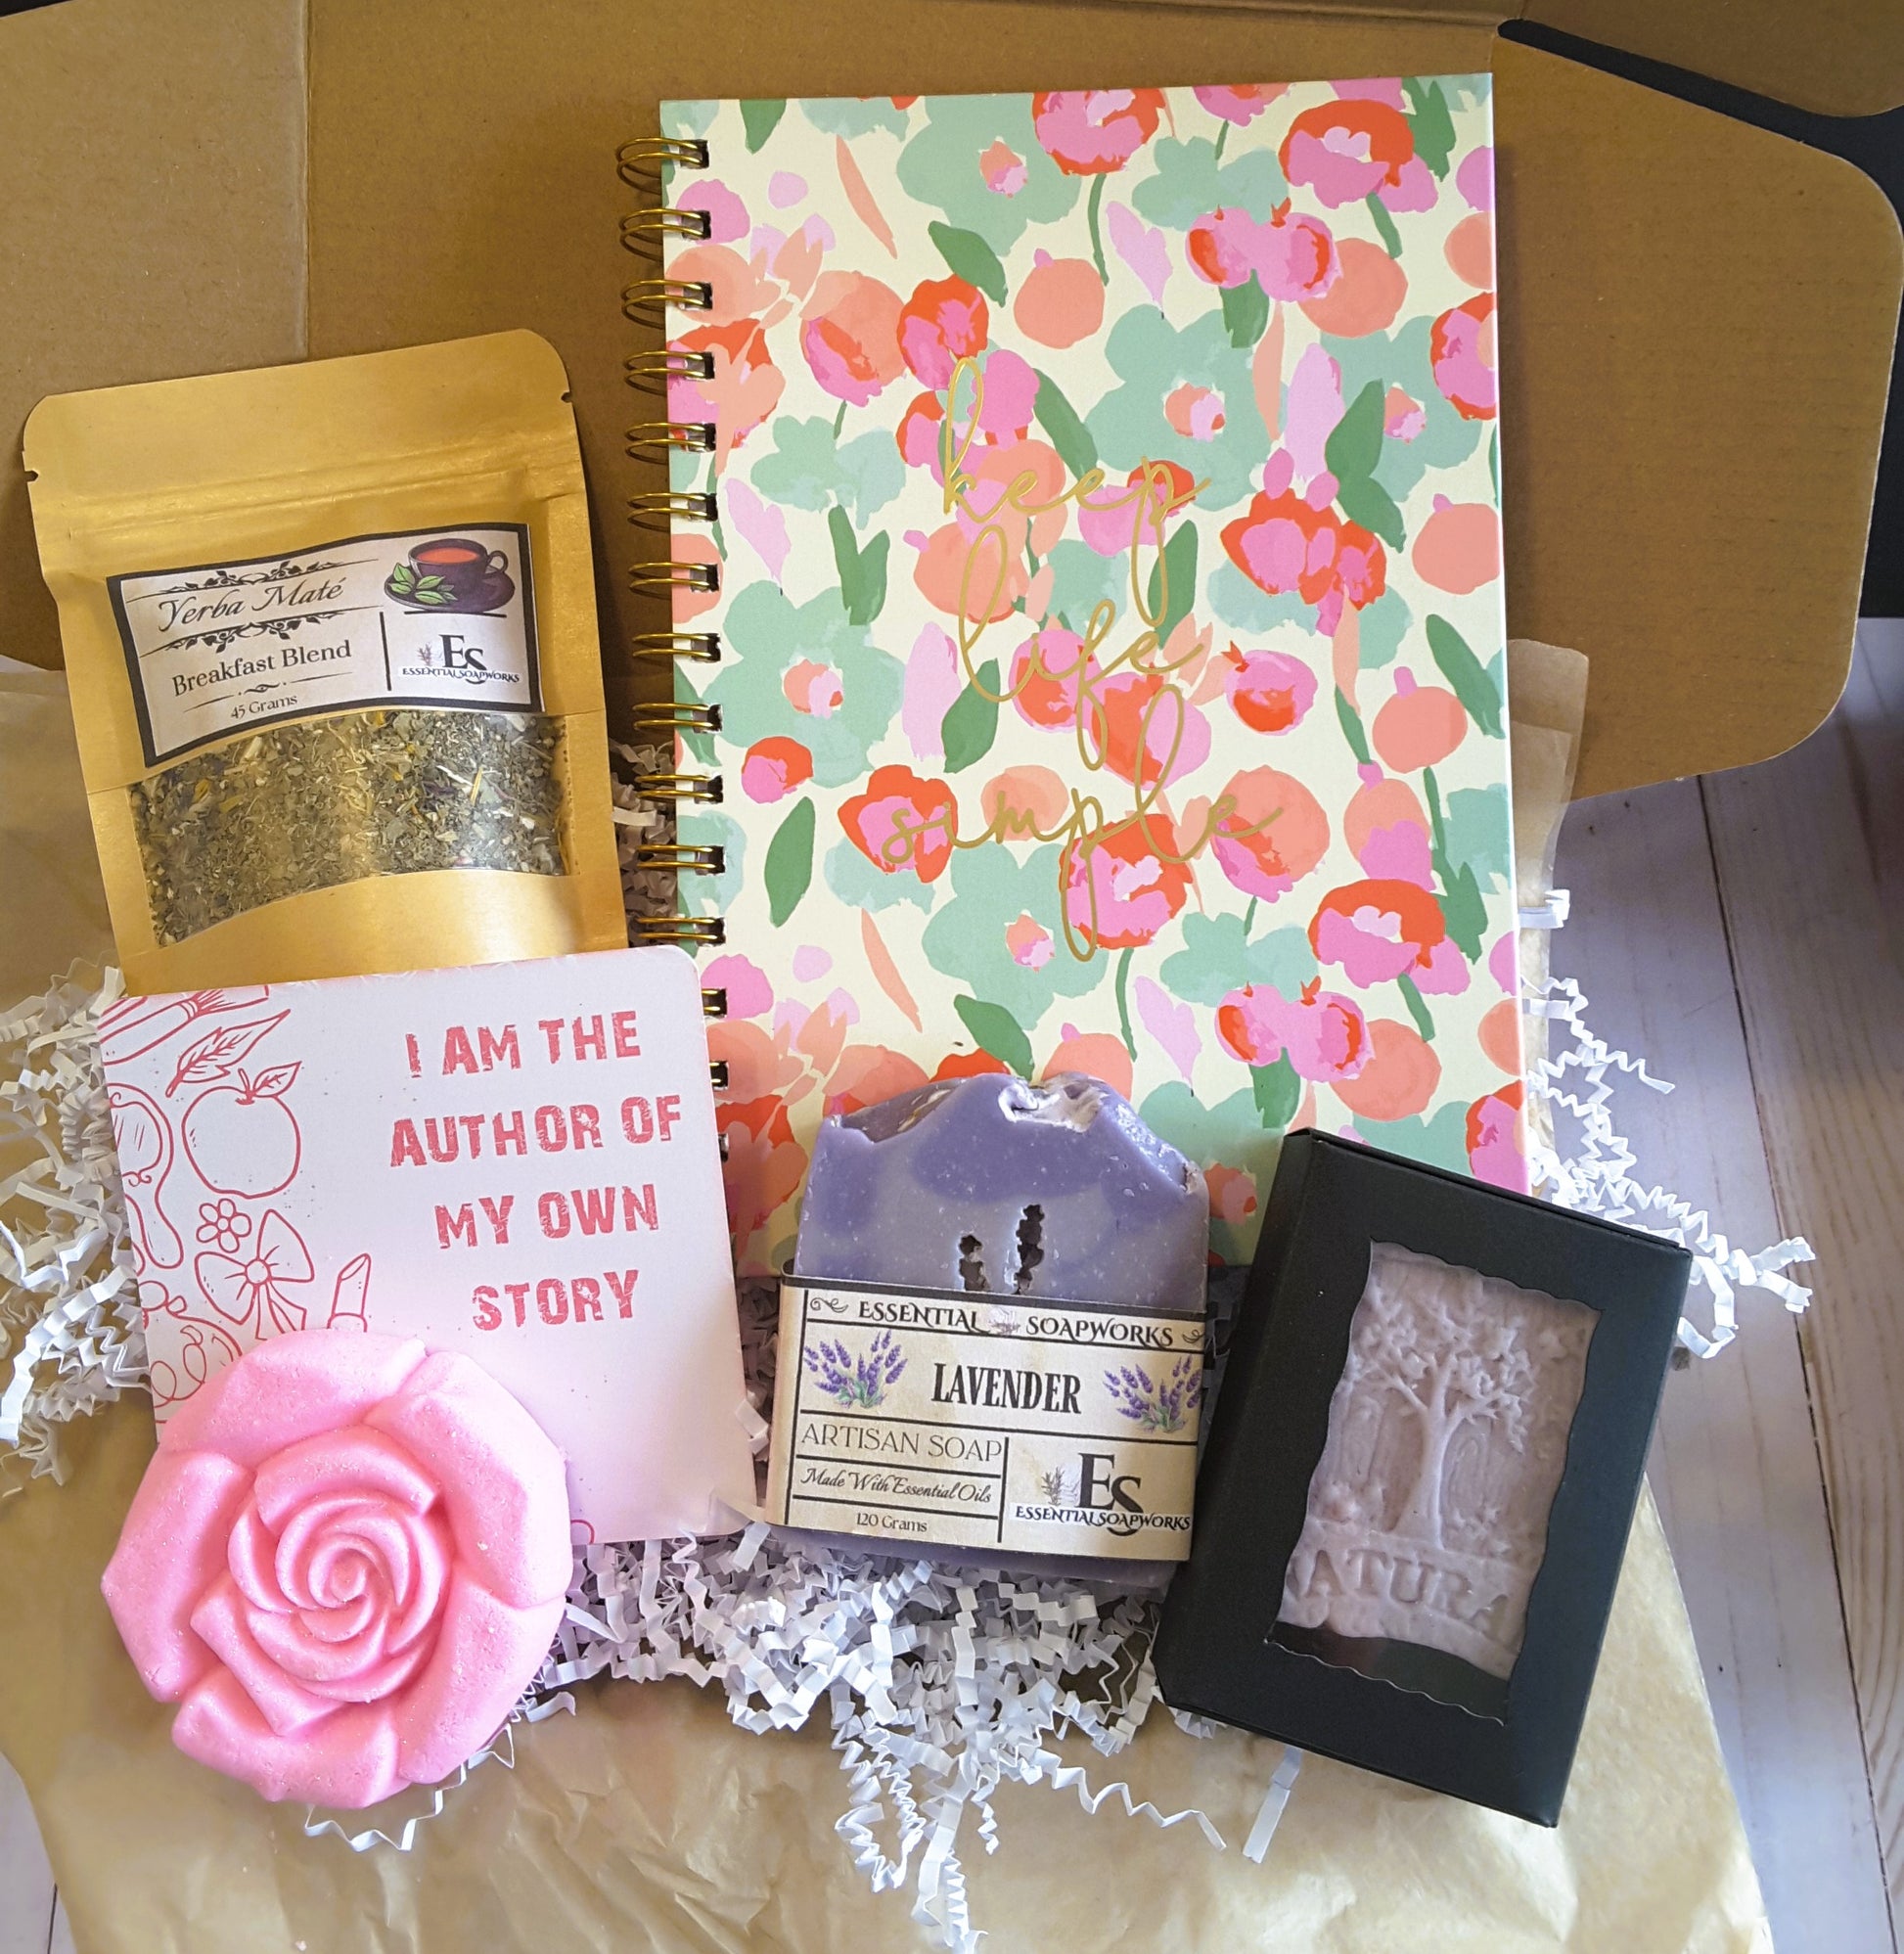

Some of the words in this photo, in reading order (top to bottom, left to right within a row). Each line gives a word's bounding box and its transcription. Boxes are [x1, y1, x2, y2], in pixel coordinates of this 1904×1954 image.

[943, 357, 1211, 628] keep
[158, 589, 245, 632] Yerba
[251, 577, 347, 611] Maté
[172, 656, 275, 697] Breakfast
[282, 639, 352, 667] Blend
[438, 634, 487, 684] Es
[958, 524, 1204, 771] life
[230, 704, 246, 719] 45
[249, 694, 297, 714] Grams
[881, 684, 1285, 963] simple
[404, 1033, 422, 1078] I
[442, 1024, 521, 1075] AM
[538, 1010, 641, 1065] THE
[390, 1104, 604, 1167] AUTHOR
[620, 1094, 681, 1144] OF
[434, 1195, 515, 1250] MY
[538, 1183, 659, 1240] OWN
[472, 1269, 639, 1331] STORY
[858, 1300, 990, 1336] ESSENTIAL
[1026, 1315, 1174, 1349] SOAPWORKS
[930, 1362, 1082, 1414] LAVENDER
[801, 1423, 920, 1455] ARTISAN
[928, 1434, 1003, 1463] SOAP
[800, 1468, 845, 1487] Made
[848, 1472, 889, 1492] With
[892, 1476, 956, 1501] Essential
[958, 1480, 992, 1503] Oils
[1075, 1452, 1144, 1537] Es
[856, 1513, 879, 1527] 120
[882, 1515, 929, 1533] Grams
